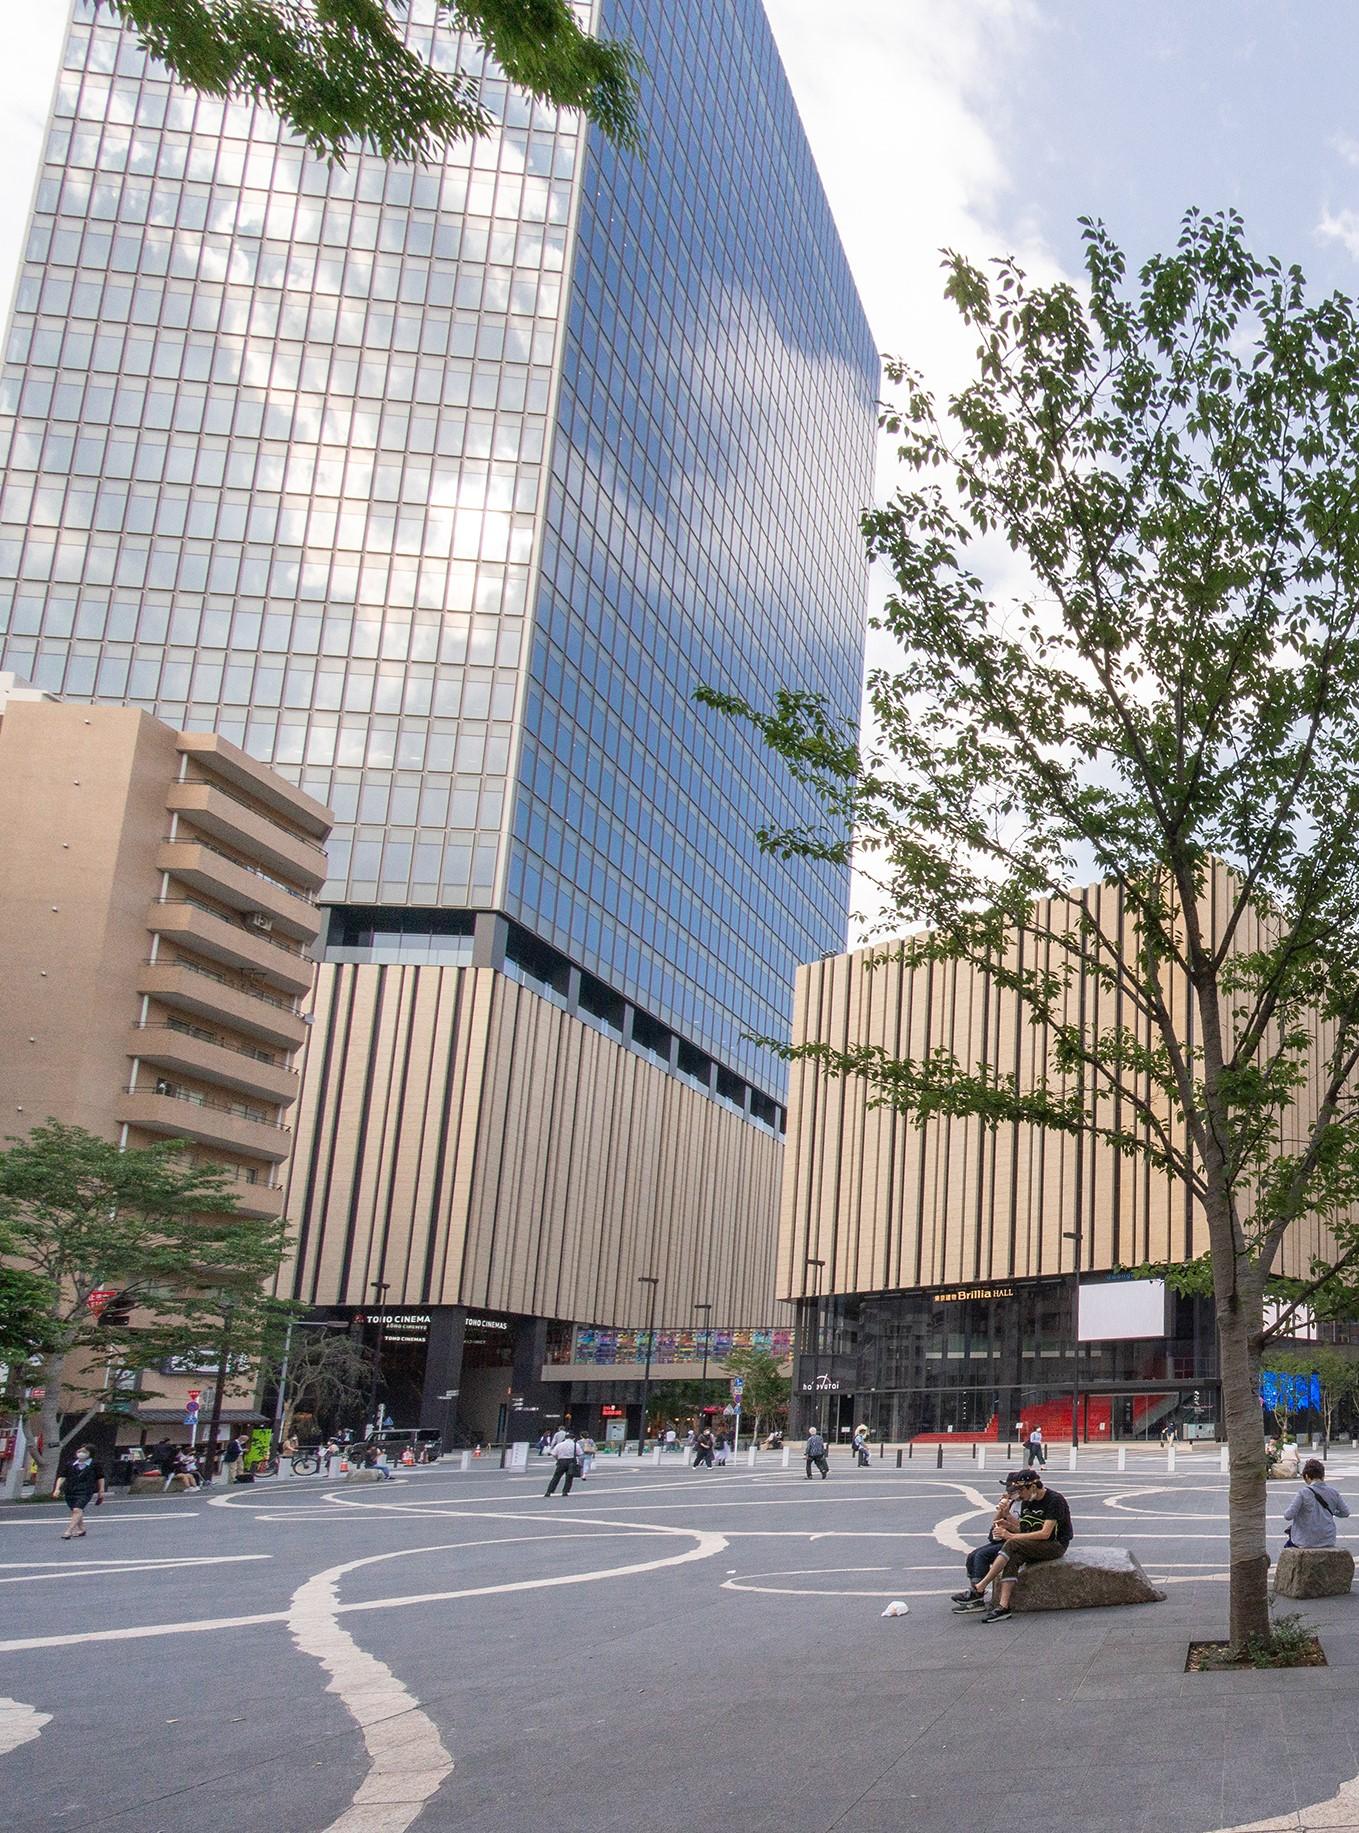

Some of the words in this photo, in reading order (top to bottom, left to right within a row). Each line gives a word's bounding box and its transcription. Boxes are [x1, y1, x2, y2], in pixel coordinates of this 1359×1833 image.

[958, 1290, 991, 1300] Brillia
[993, 1289, 1014, 1298] HALL
[367, 1315, 393, 1324] TOHO
[395, 1315, 431, 1323] CINEMA
[465, 1317, 481, 1327] TOHO
[481, 1320, 508, 1330] CINEMAS
